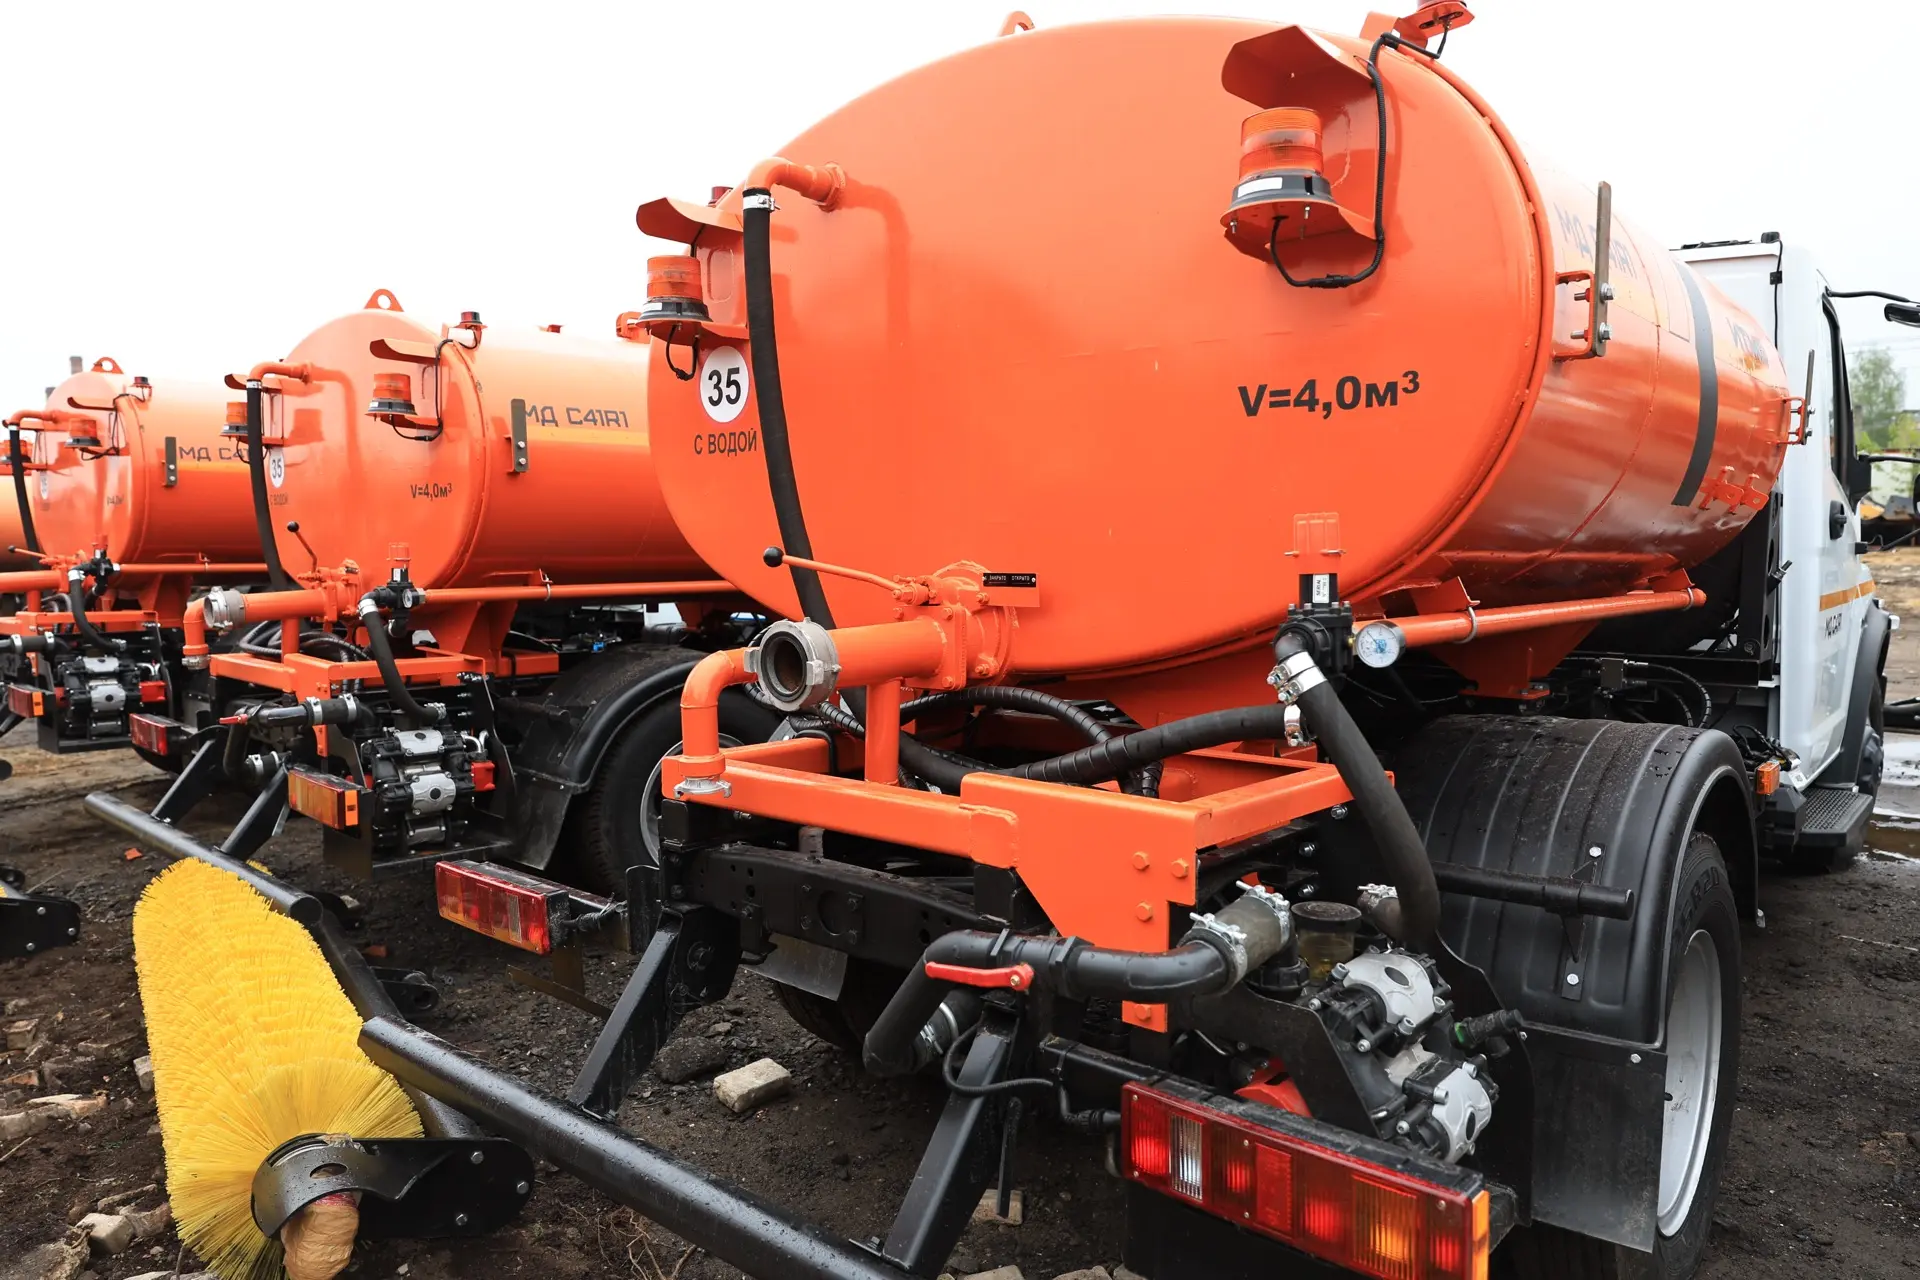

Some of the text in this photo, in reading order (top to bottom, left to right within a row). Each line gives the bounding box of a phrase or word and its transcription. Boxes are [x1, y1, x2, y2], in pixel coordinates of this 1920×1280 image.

[708, 367, 741, 407] 35
[178, 446, 212, 462] МД
[694, 427, 757, 457] С ВОДОЙ
[271, 458, 283, 479] 35
